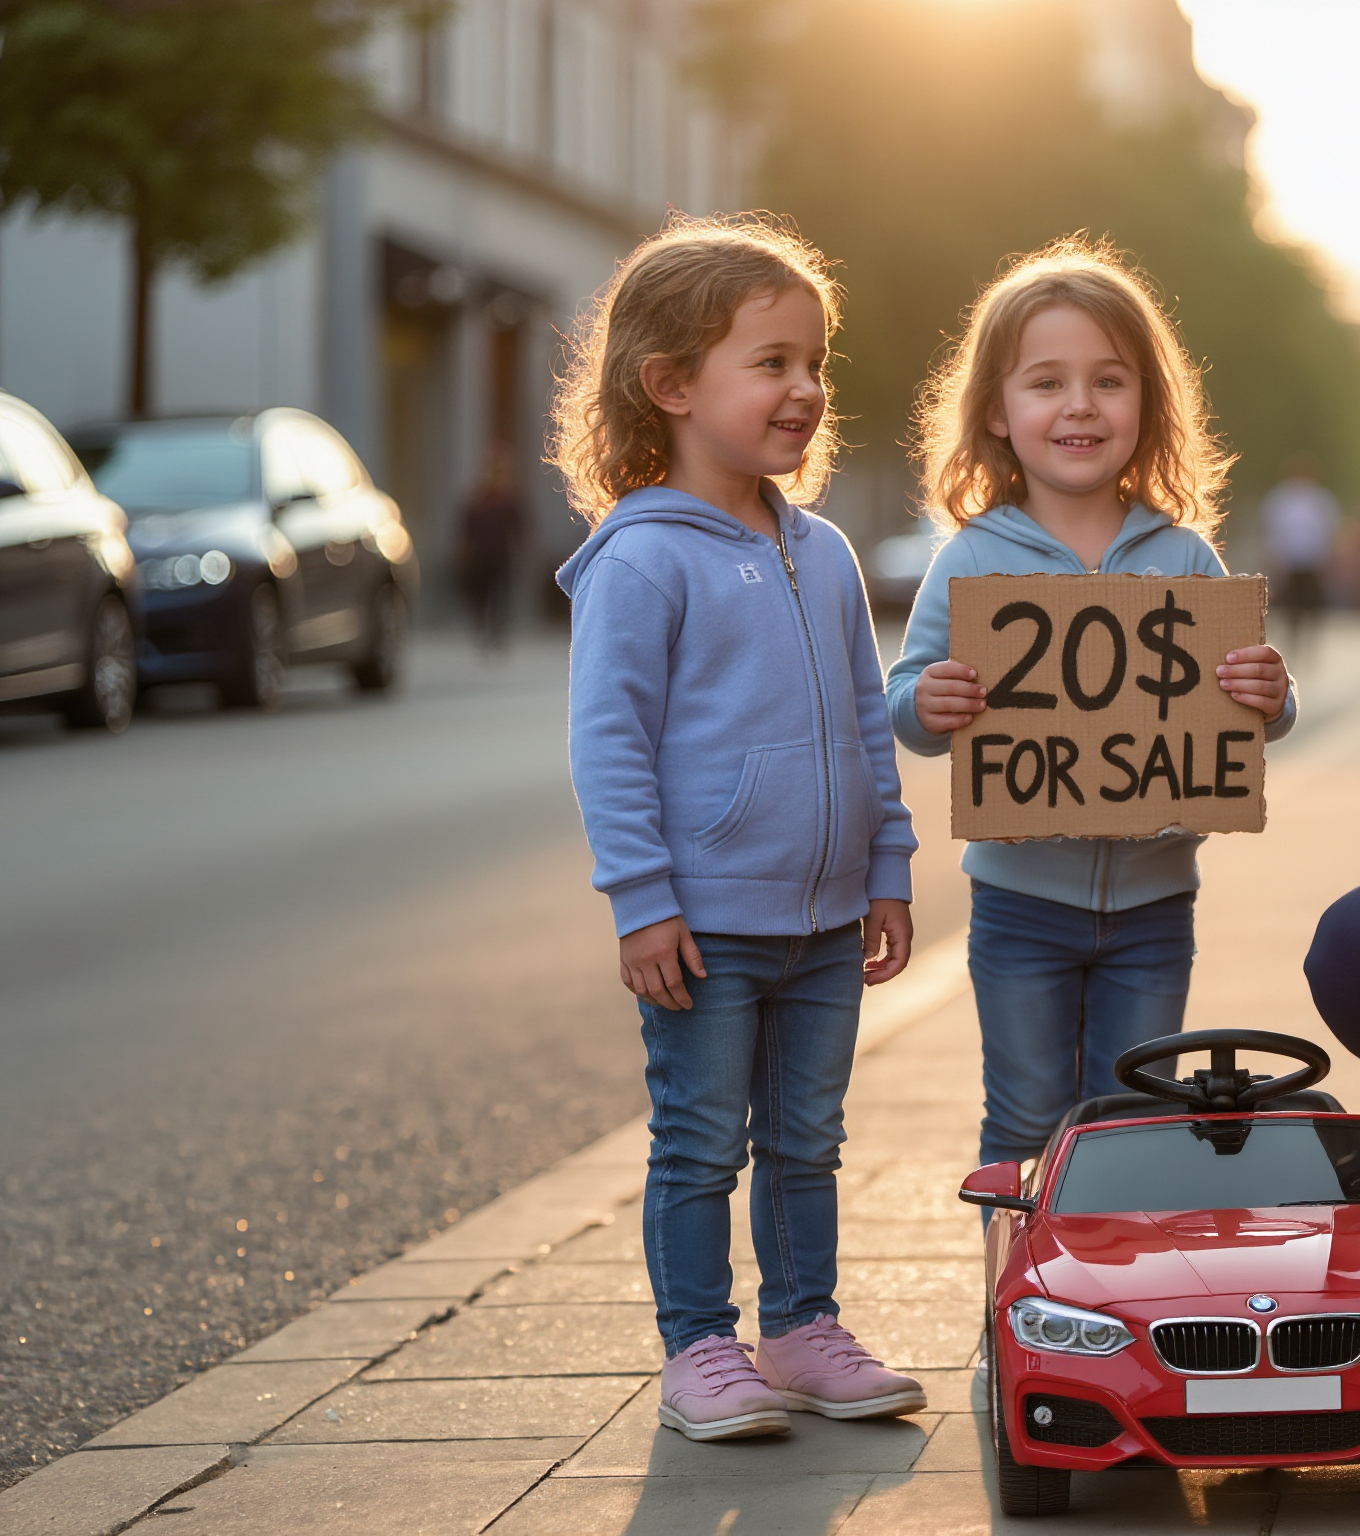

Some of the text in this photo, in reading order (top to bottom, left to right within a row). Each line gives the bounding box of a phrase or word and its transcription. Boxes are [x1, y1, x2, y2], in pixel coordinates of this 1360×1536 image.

[986, 589, 1200, 721] 20$
[971, 731, 1254, 808] FOR SALE
